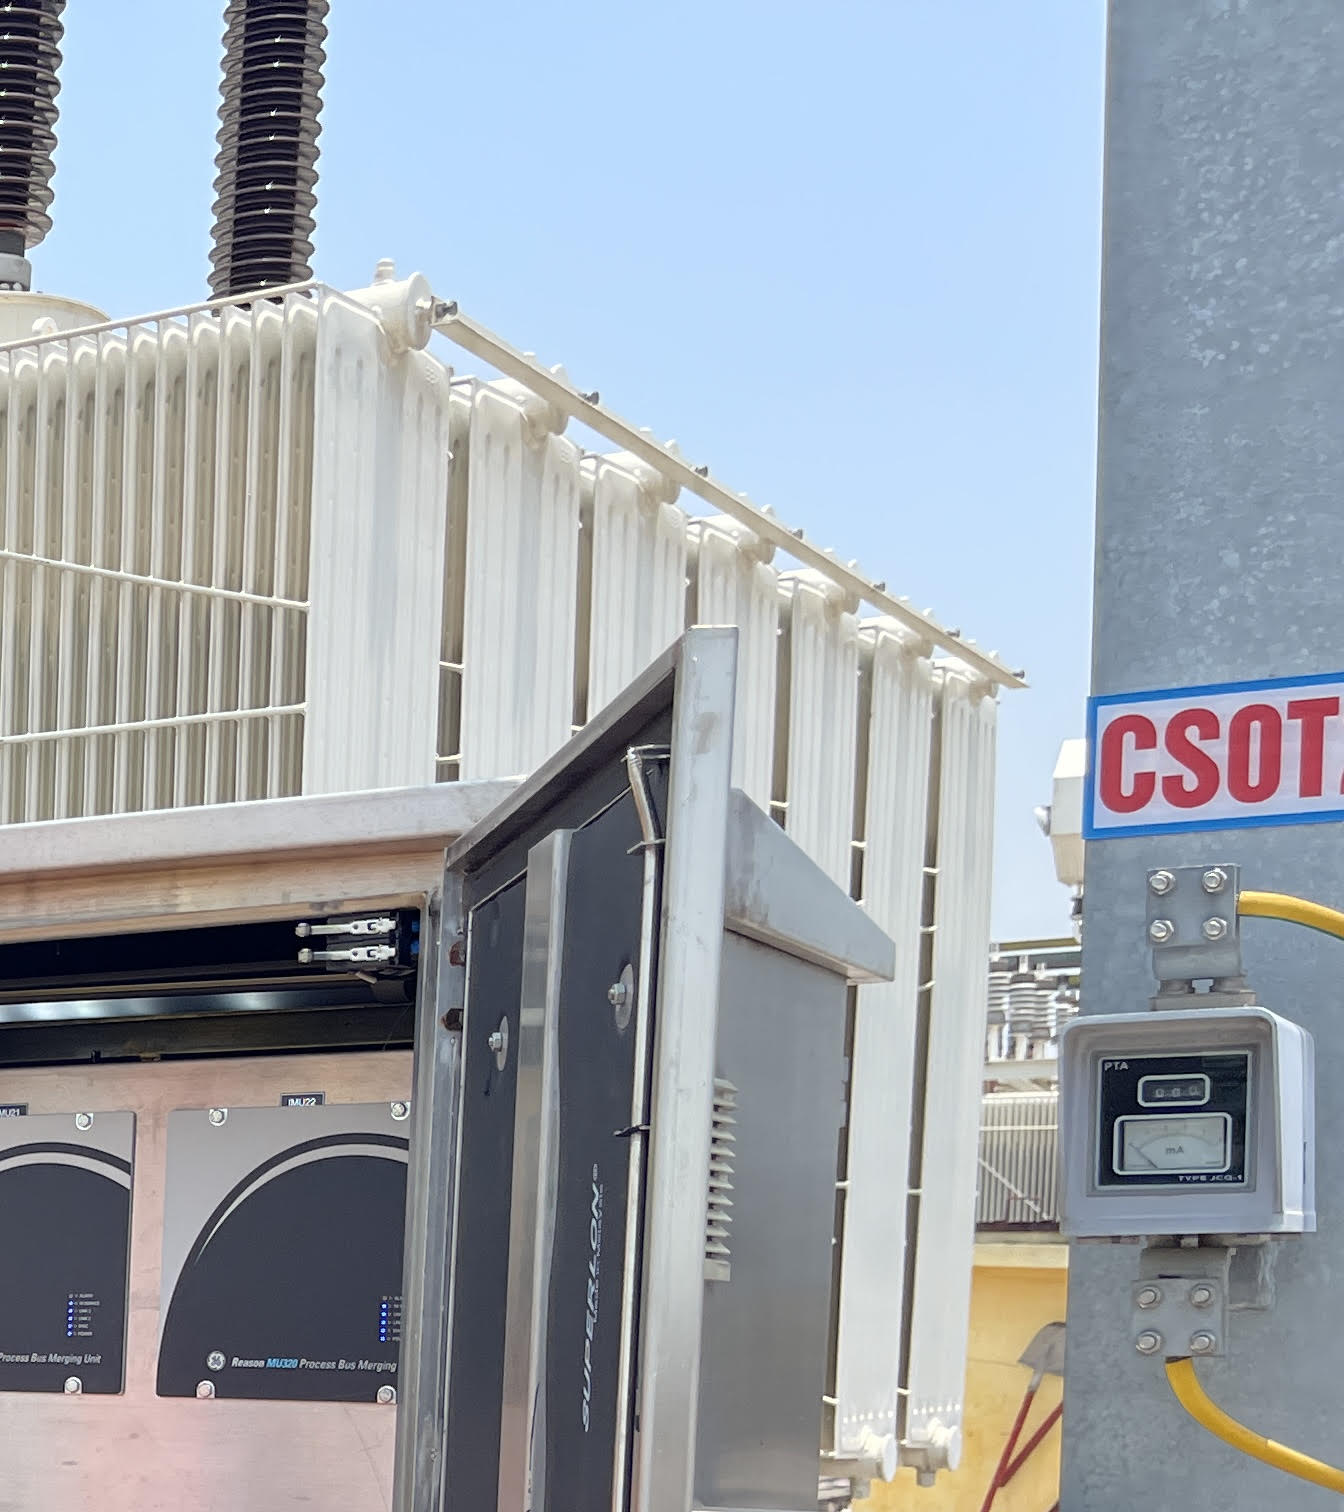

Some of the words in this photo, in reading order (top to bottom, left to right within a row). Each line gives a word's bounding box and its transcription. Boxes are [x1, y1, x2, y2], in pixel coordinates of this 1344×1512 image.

[1100, 697, 1344, 813] CSOT
[1104, 1061, 1129, 1071] PTA
[582, 1182, 600, 1433] SUPERLON
[31, 1353, 47, 1363] Bus
[48, 1354, 82, 1365] Merging
[84, 1354, 101, 1364] Unit
[231, 1357, 265, 1368] Reason
[266, 1358, 298, 1368] MU320
[299, 1359, 336, 1370] Process
[338, 1360, 356, 1370] Bus
[357, 1360, 397, 1372] Merging
